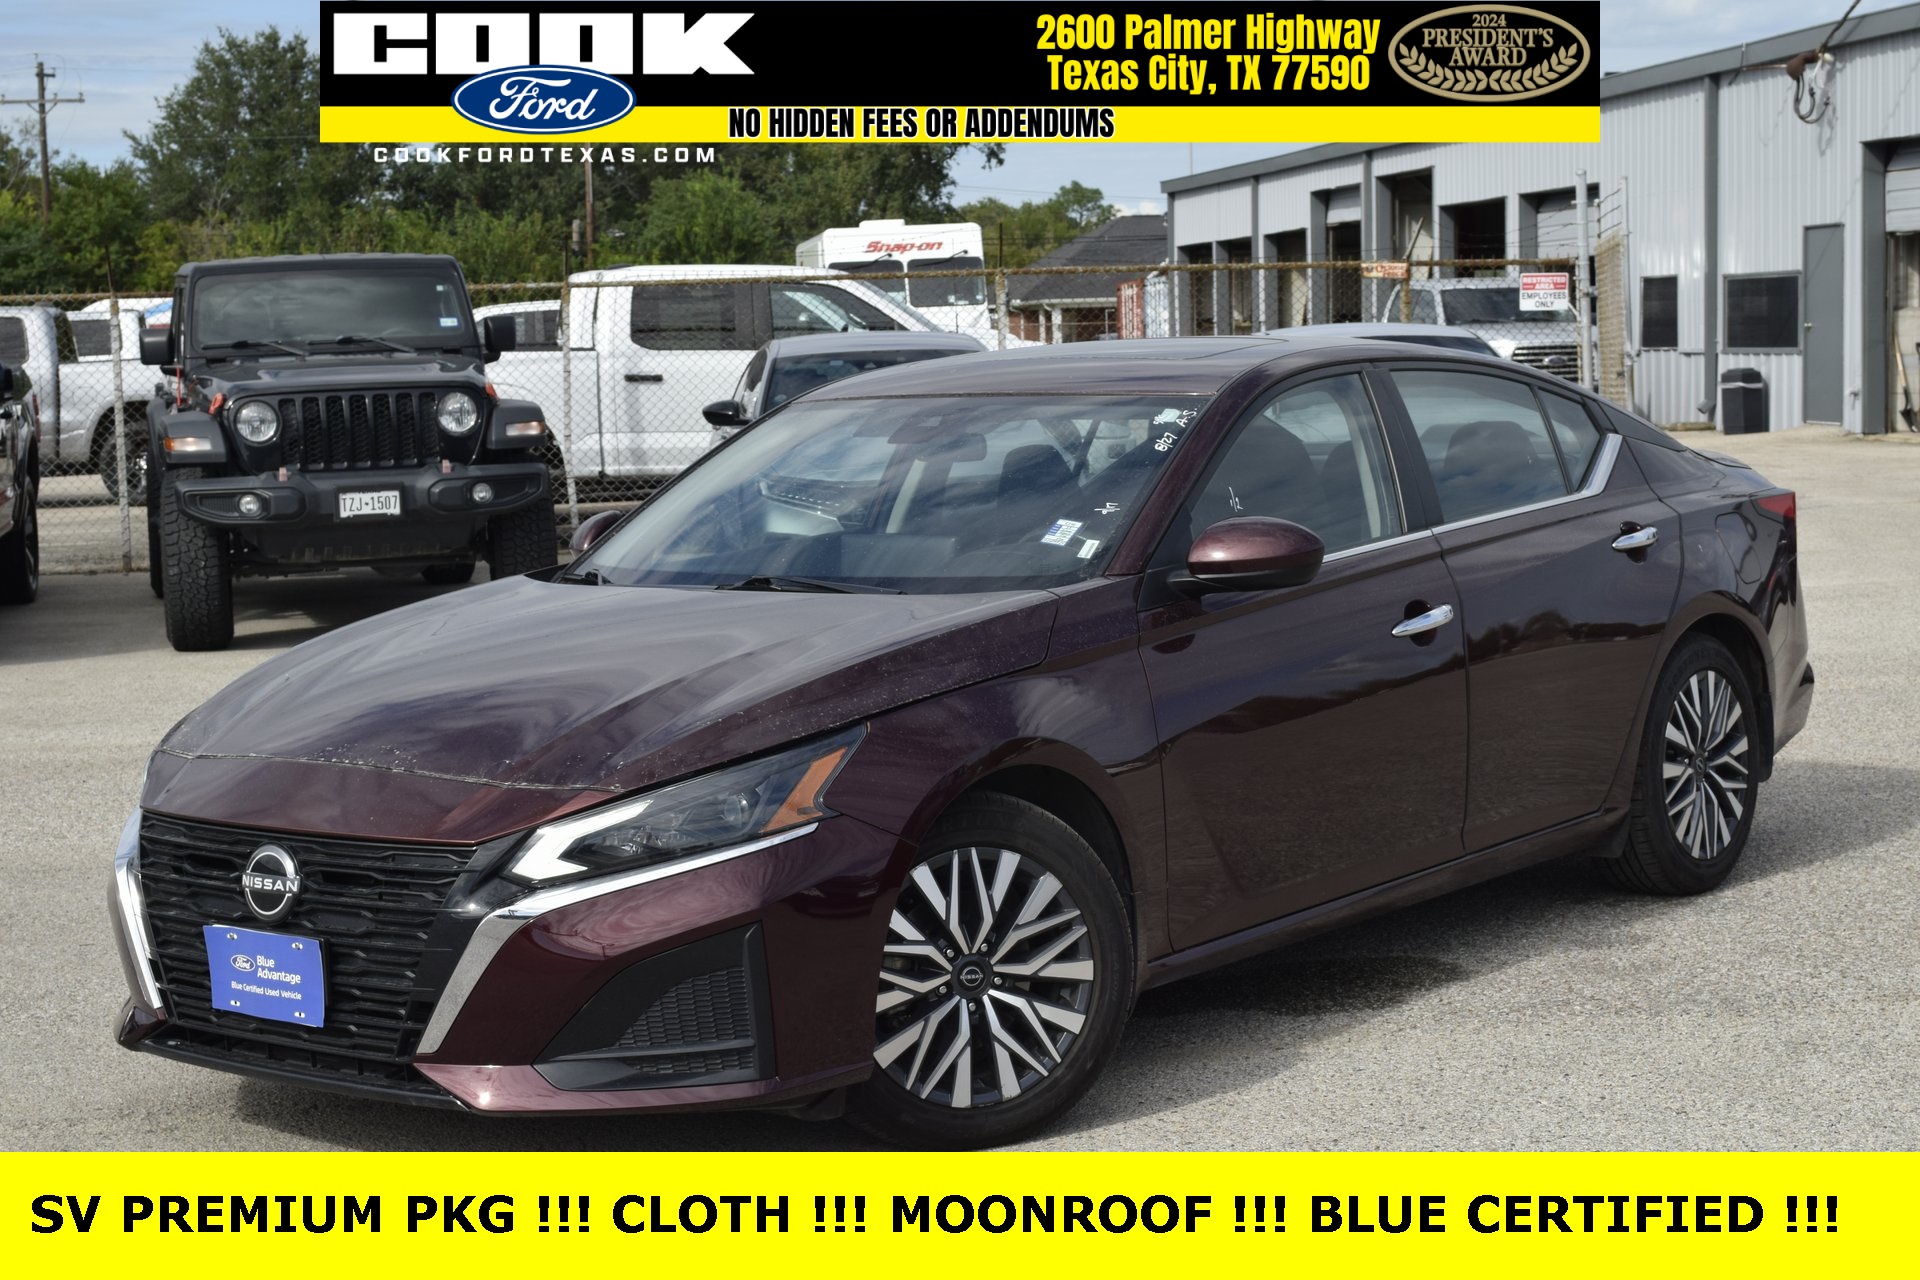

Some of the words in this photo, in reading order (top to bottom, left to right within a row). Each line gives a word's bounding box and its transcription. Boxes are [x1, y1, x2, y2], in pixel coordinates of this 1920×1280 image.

[864, 240, 943, 254] Snap-on
[1522, 276, 1567, 284] RESTRICTED
[1521, 291, 1567, 300] EMPLOYEES
[1534, 300, 1554, 308] ONLY
[1154, 432, 1178, 451] 8/27
[242, 874, 298, 892] NISSAN
[235, 956, 251, 969] Ford
[256, 955, 275, 968] Blue
[257, 967, 301, 985] Advantage
[231, 980, 243, 991] Blue
[243, 983, 264, 995] Certified
[264, 987, 280, 997] Used
[280, 989, 302, 1000] Vehicle
